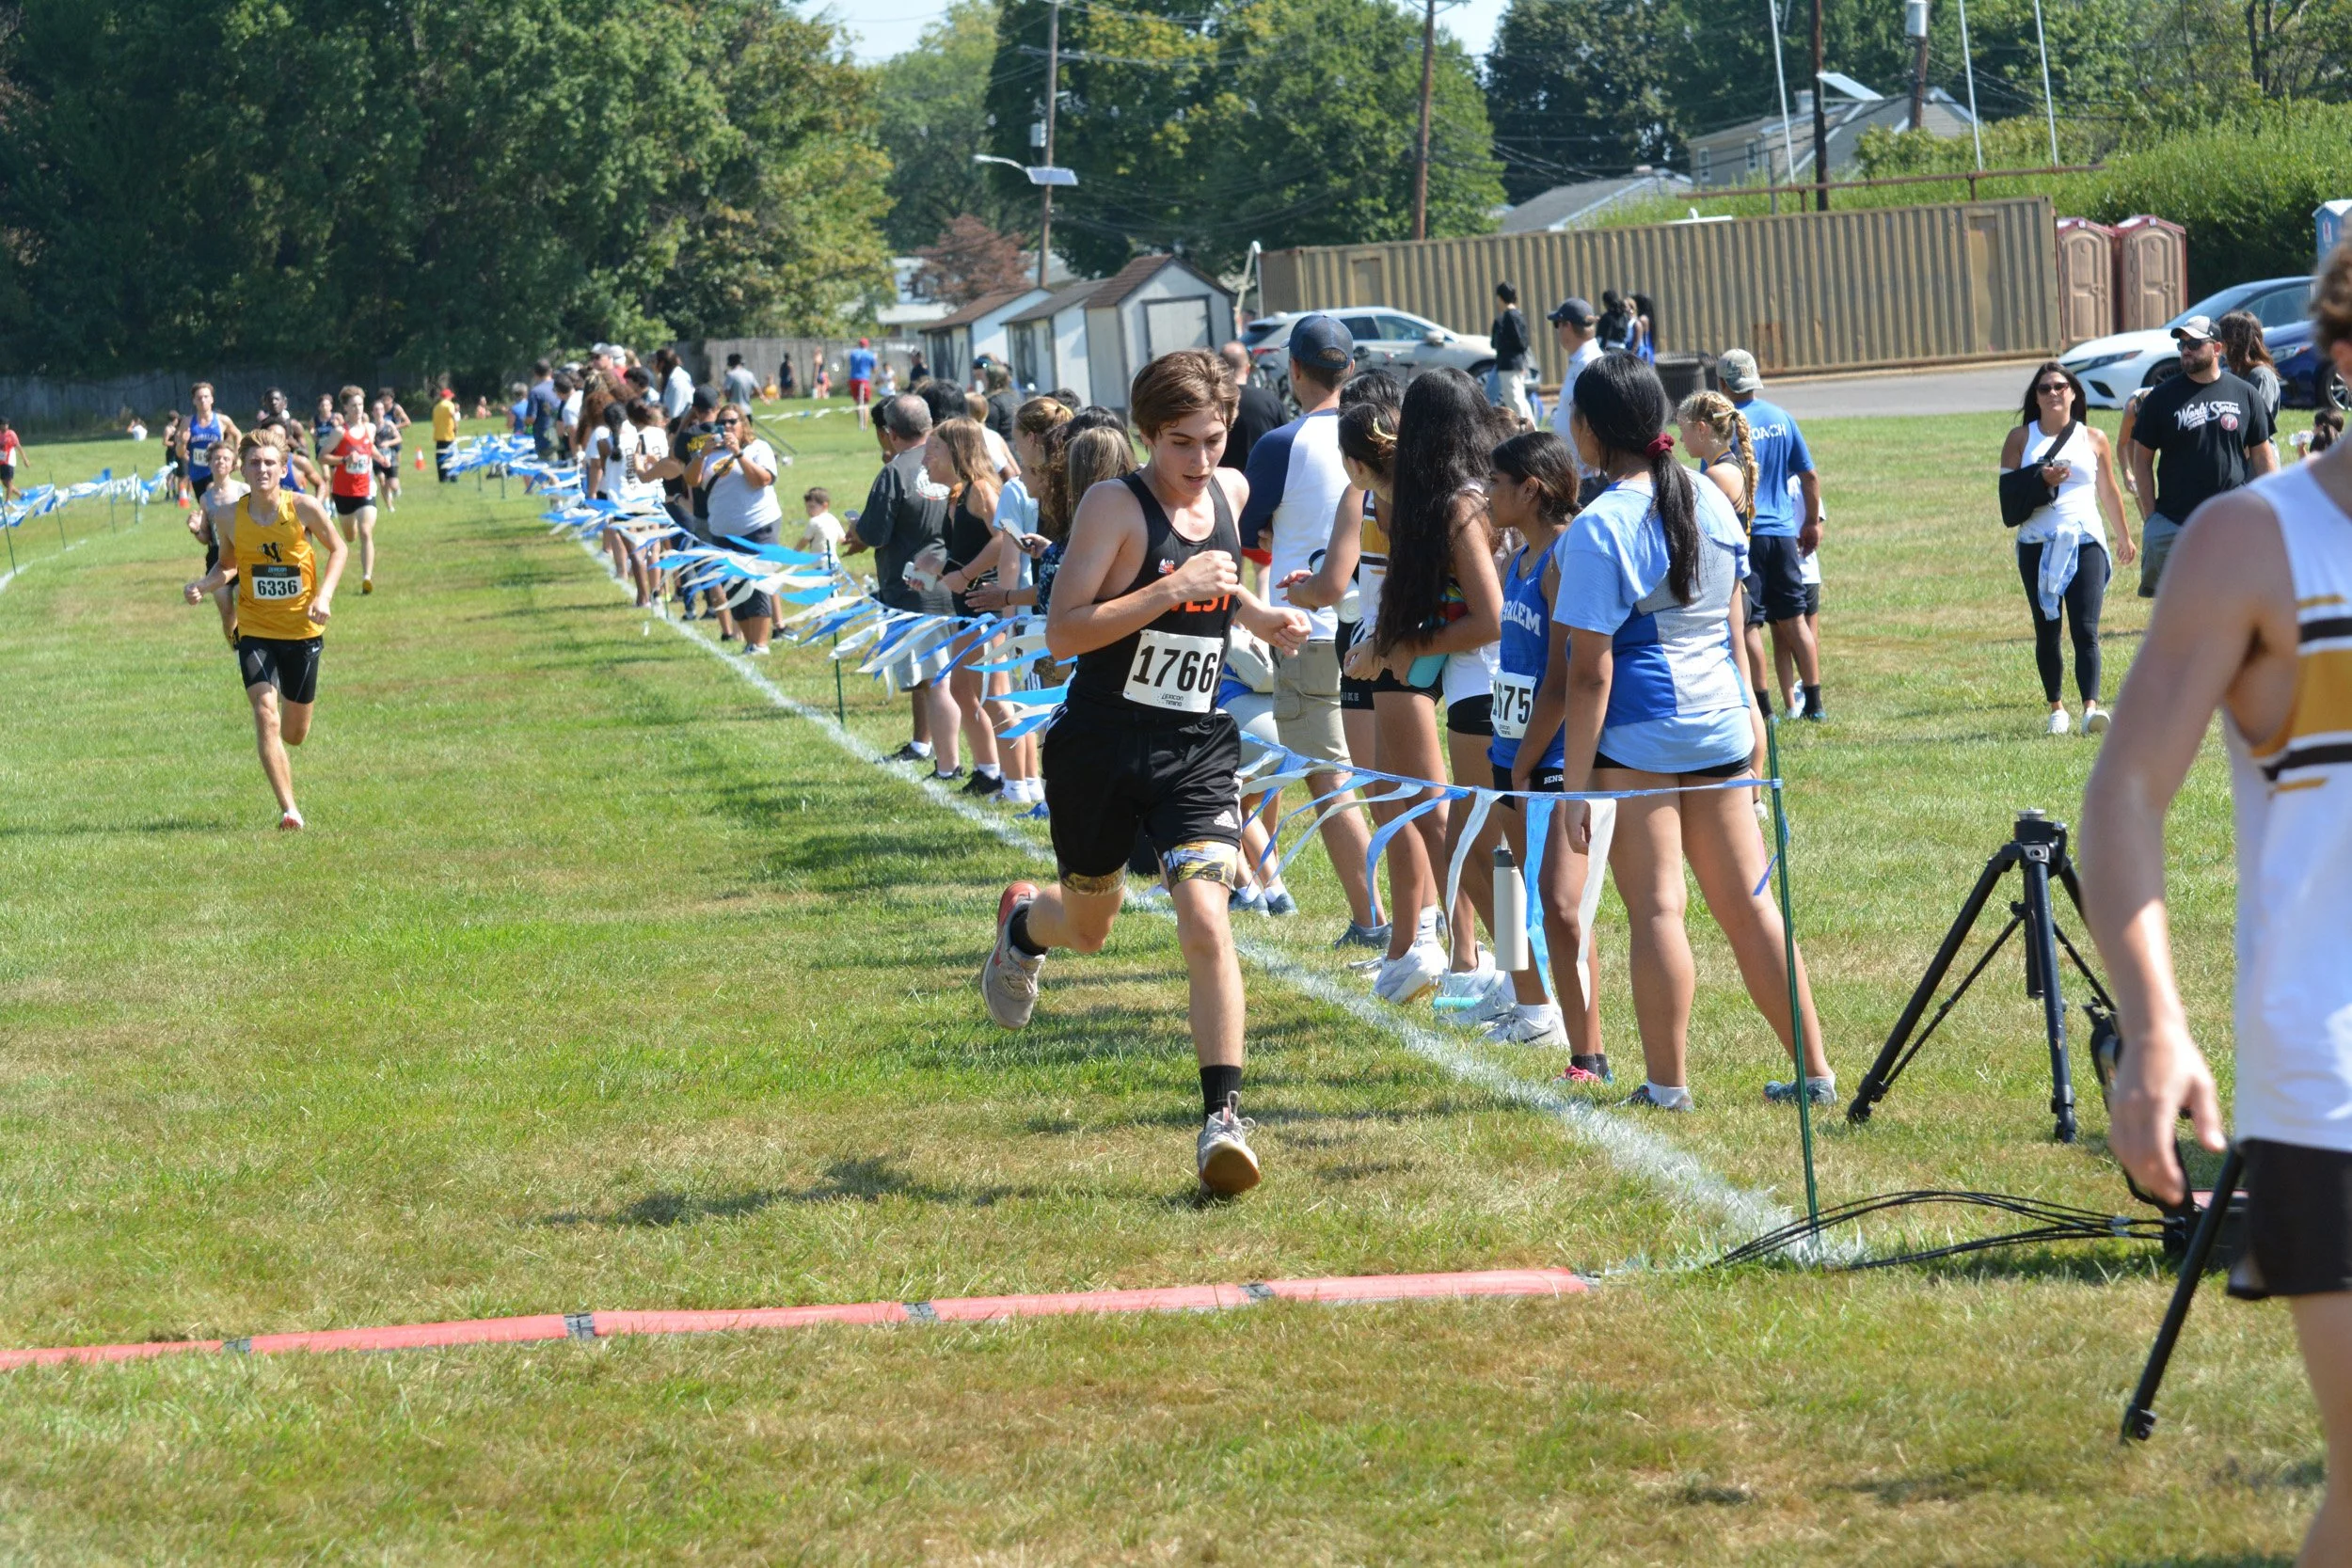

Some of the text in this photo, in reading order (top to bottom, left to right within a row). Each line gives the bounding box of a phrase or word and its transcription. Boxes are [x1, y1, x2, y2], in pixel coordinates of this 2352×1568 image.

[1750, 422, 1787, 441] OACH
[257, 579, 298, 596] 6336
[1133, 645, 1217, 693] 1766
[1492, 680, 1532, 724] 1675
[1544, 774, 1564, 784] BENS
